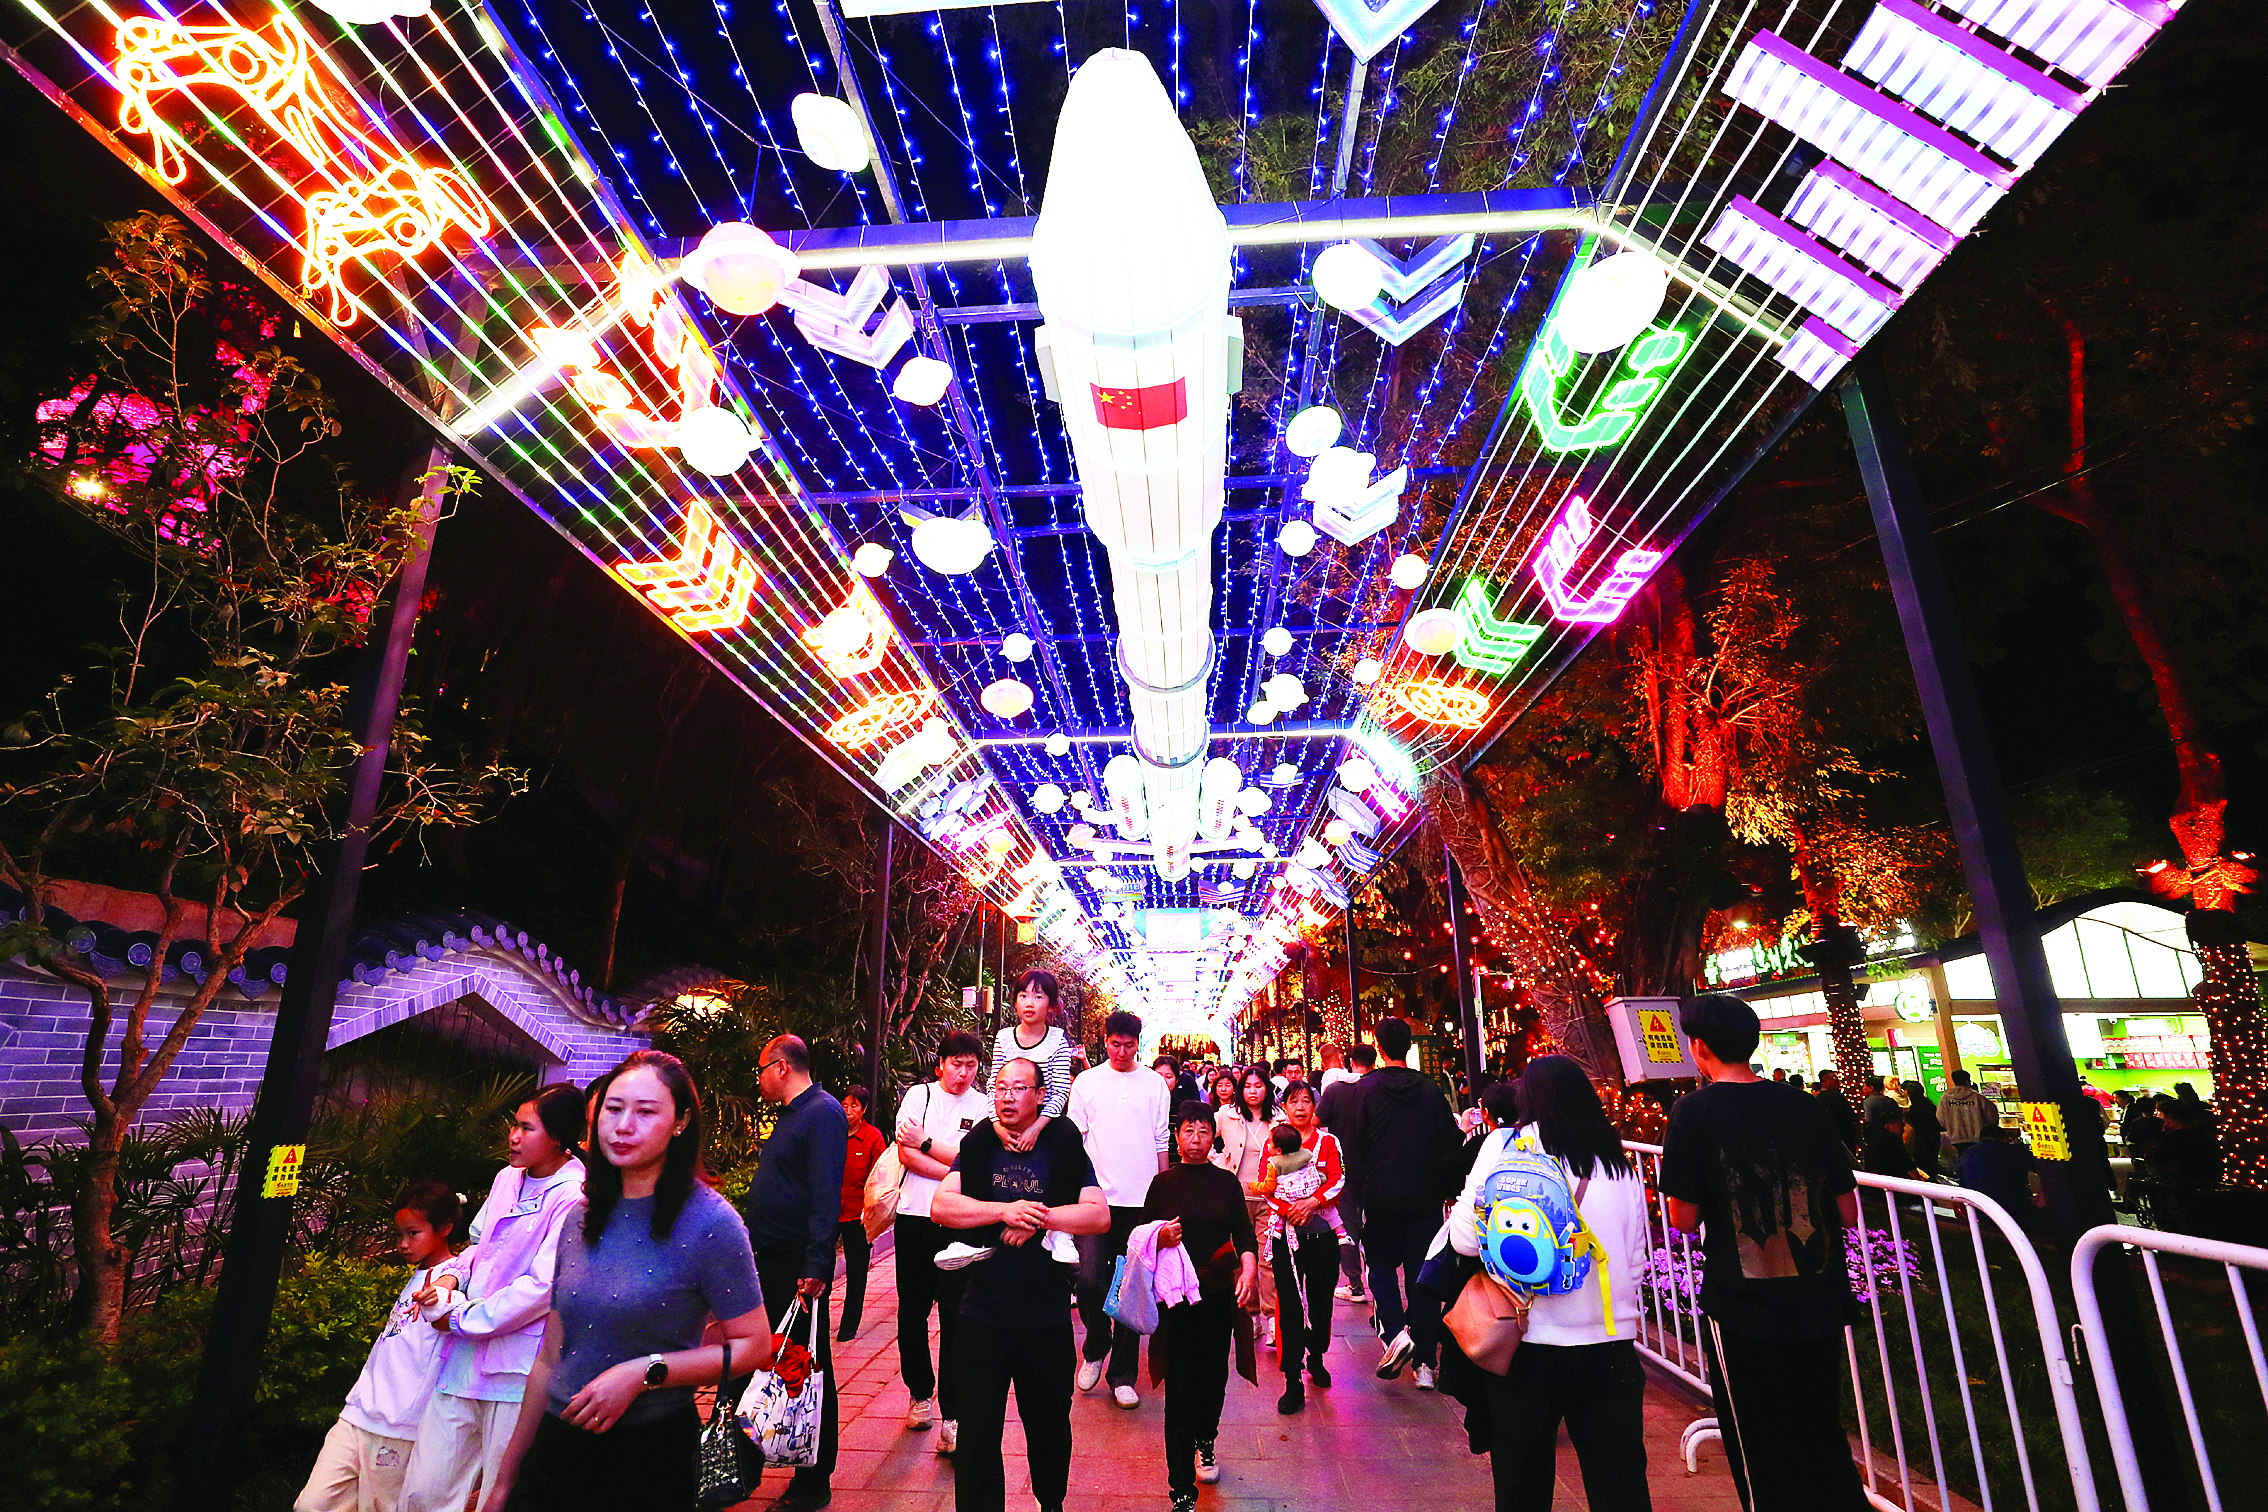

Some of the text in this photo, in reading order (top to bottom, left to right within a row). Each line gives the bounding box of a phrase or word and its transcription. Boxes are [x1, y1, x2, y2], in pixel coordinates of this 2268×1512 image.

[1648, 1034, 1673, 1042] 有电危险
[1500, 1176, 1528, 1187] SUPER
[1496, 1183, 1521, 1193] WINGS
